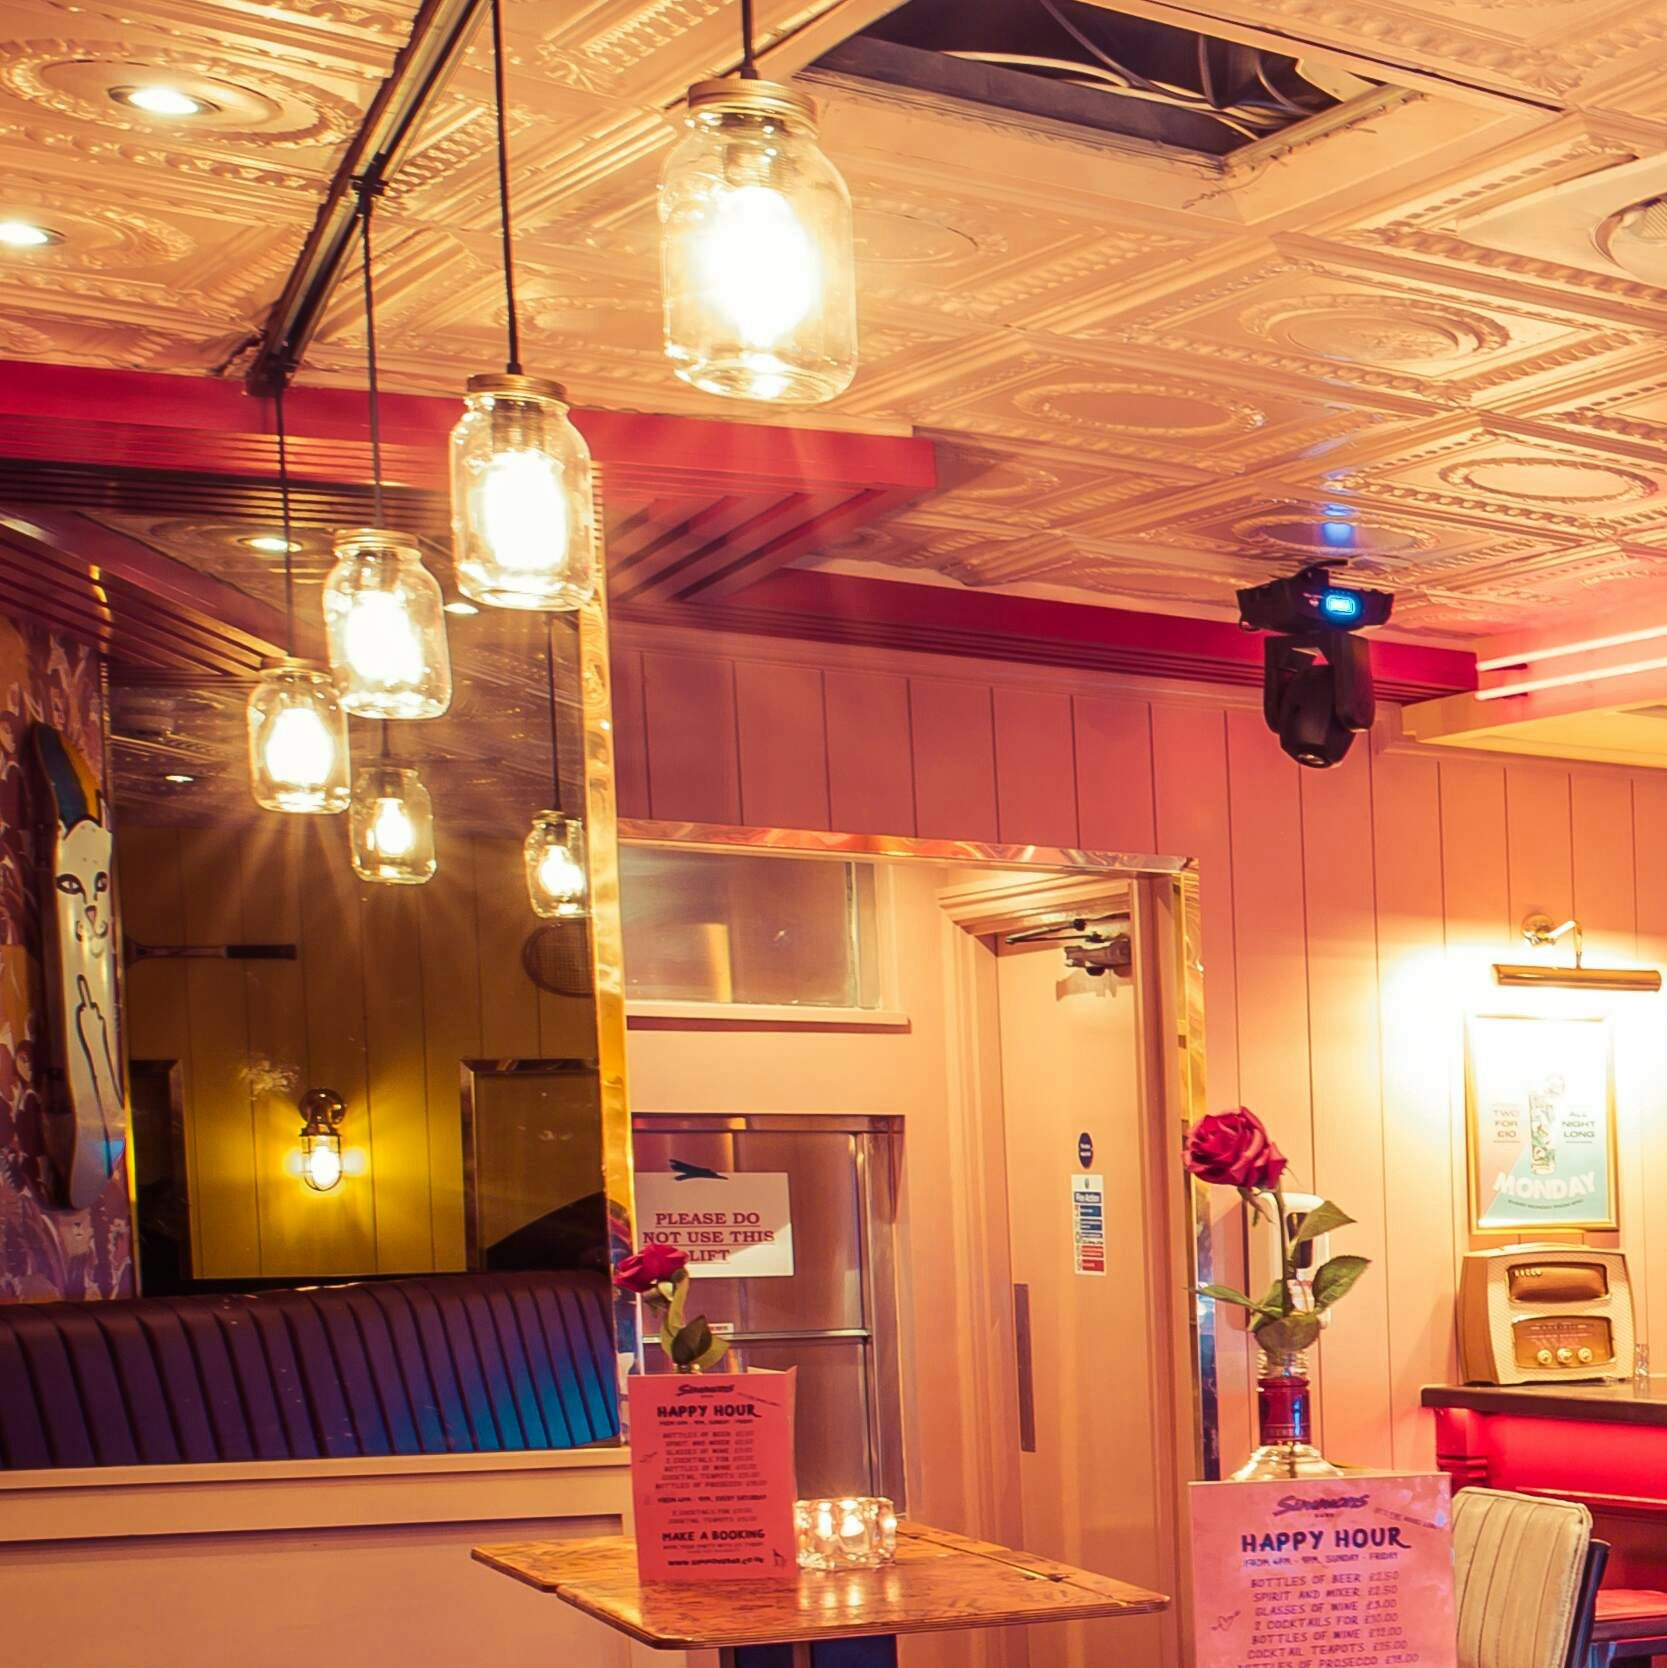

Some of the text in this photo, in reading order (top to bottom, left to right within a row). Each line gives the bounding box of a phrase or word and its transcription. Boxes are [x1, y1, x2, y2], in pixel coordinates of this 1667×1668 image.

[1493, 1171, 1596, 1200] MONDAY
[655, 1212, 760, 1225] PLEASE DO
[643, 1230, 775, 1244] NOT USE THIS
[690, 1249, 730, 1262] LIFT
[656, 1403, 763, 1418] HAPPY HOUR
[661, 1528, 766, 1542] MAKE A BOOKING
[1241, 1526, 1411, 1553] HAPPY HOUR
[1251, 1576, 1306, 1588] BOTTLES
[1311, 1574, 1326, 1585] OF
[1331, 1573, 1361, 1584] BEER
[1253, 1591, 1291, 1602] SPIRIT
[1298, 1589, 1320, 1600] AND
[1326, 1587, 1361, 1598] MIXER
[1254, 1605, 1306, 1617] GLASSES
[1311, 1603, 1325, 1613] OF
[1331, 1601, 1359, 1612] WINE
[1266, 1617, 1331, 1630] COCKTAILS
[1336, 1615, 1358, 1626] FOR
[1251, 1632, 1308, 1645] BOTTLES
[1313, 1631, 1327, 1641] OF
[1333, 1629, 1361, 1639] WINE
[1247, 1646, 1304, 1660] COCKTAIL
[1311, 1643, 1366, 1656] TEAPOTS
[1319, 1656, 1378, 1668] PROSECCO
